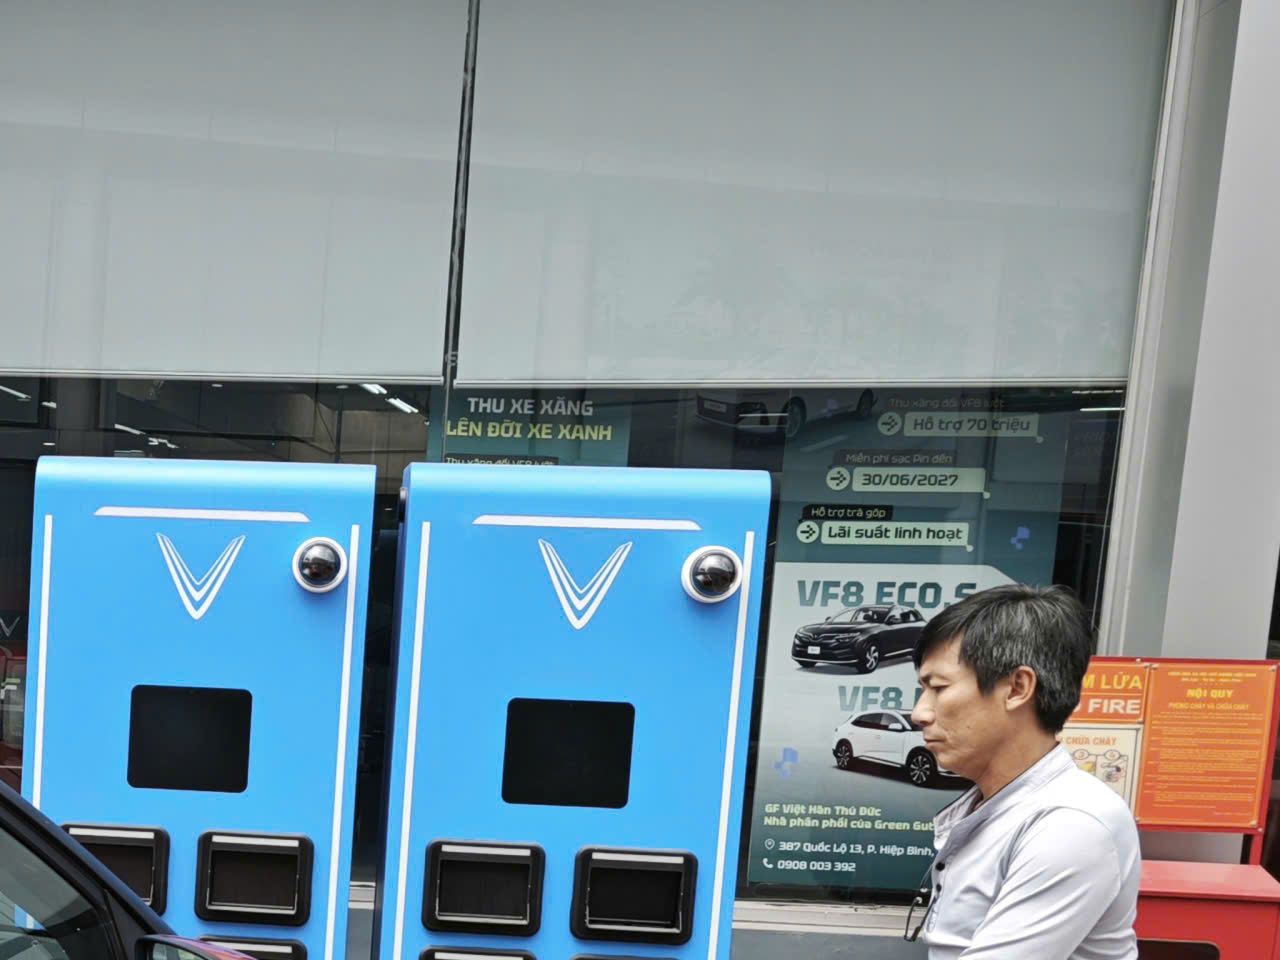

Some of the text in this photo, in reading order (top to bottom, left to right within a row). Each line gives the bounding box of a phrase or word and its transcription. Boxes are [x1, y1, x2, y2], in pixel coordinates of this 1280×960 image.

[467, 396, 594, 416] THU XE XĂNG
[446, 417, 482, 437] LÊN
[527, 423, 553, 439] XE
[557, 424, 612, 441] XANH
[966, 418, 987, 431] 70
[991, 417, 1031, 434] triệu
[861, 474, 959, 487] 30/06/2027
[827, 525, 963, 542] Lãi suất linh hoạt
[797, 580, 864, 607] VF8
[839, 686, 903, 712] VF8
[1088, 698, 1142, 714] FIRE
[765, 803, 780, 814] GF
[782, 804, 806, 815] Việt
[874, 819, 910, 830] Green
[779, 841, 801, 851] 387
[849, 844, 865, 855] 13,
[867, 845, 877, 854] P.
[880, 845, 904, 856] Hiệp
[777, 860, 857, 872] 0908 003 392
